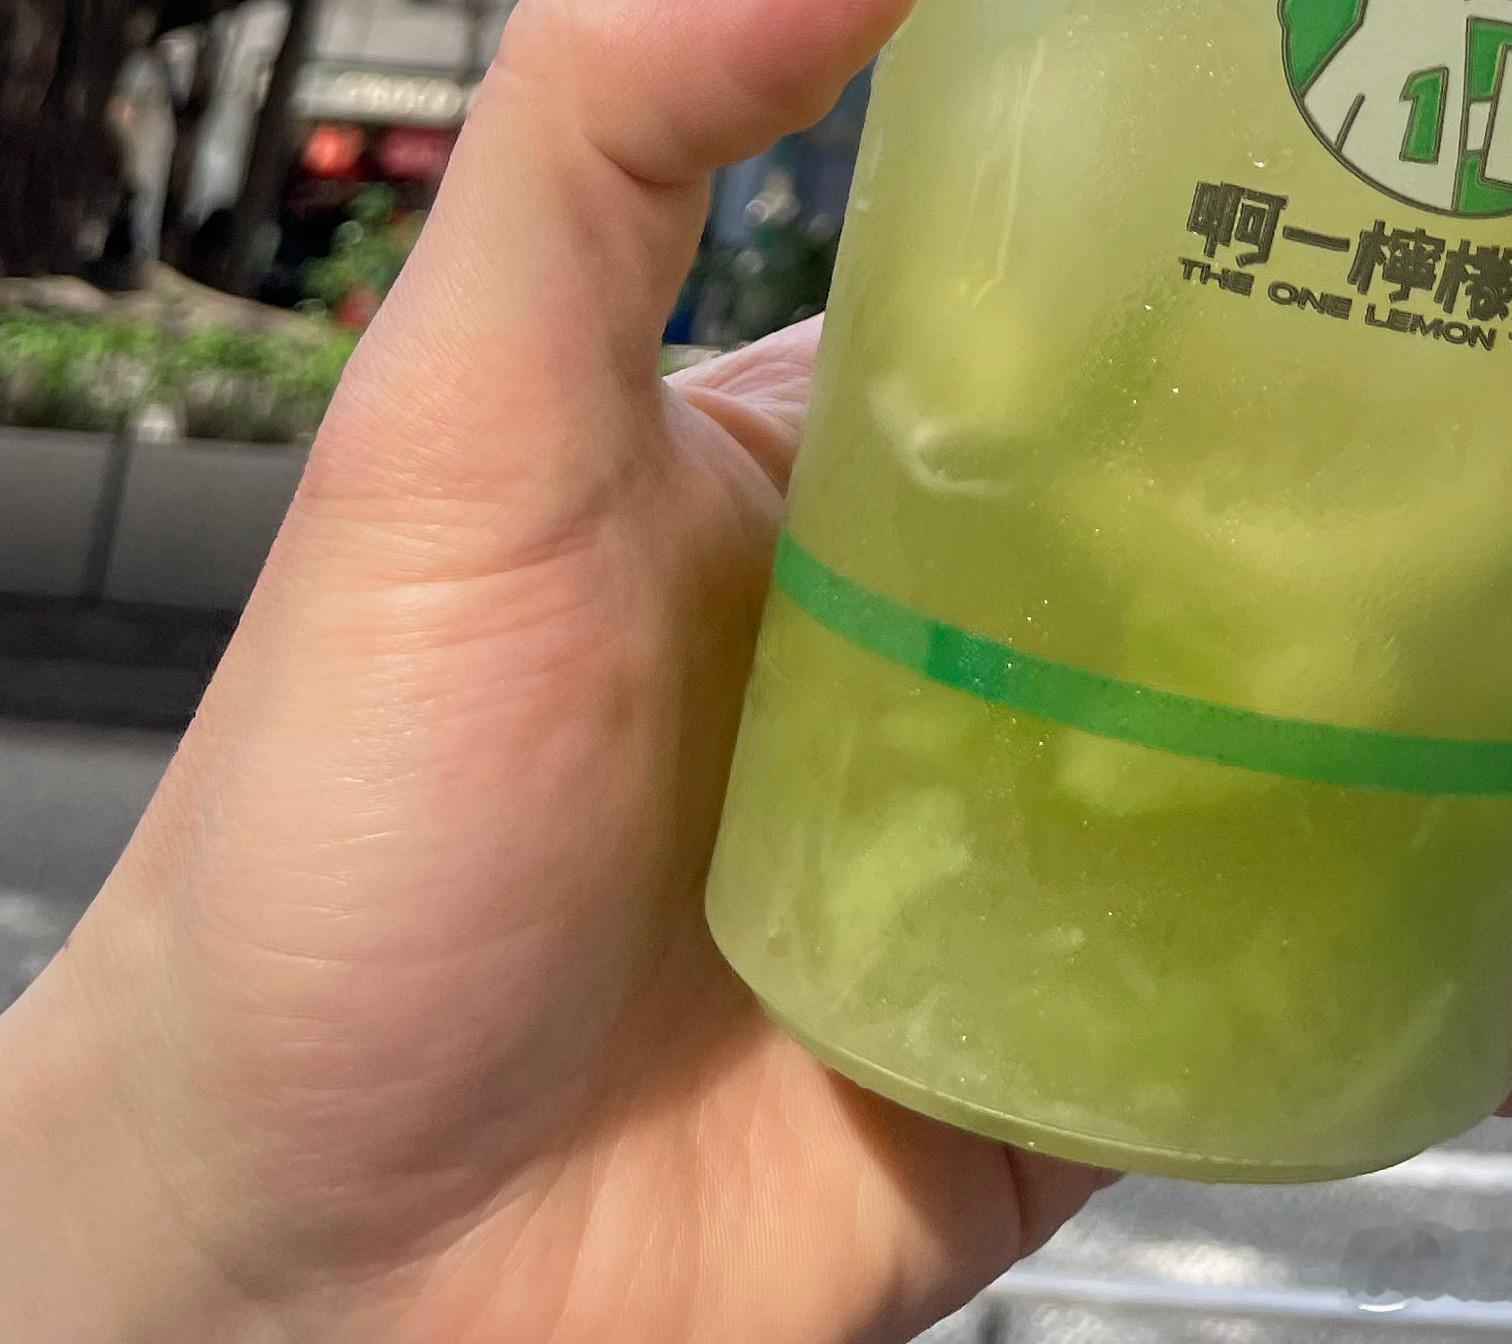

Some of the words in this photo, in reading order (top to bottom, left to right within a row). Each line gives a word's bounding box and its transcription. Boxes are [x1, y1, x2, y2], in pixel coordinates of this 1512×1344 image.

[1179, 257, 1255, 297] THE
[1268, 280, 1353, 320] ONE
[1365, 304, 1498, 351] LEMON
